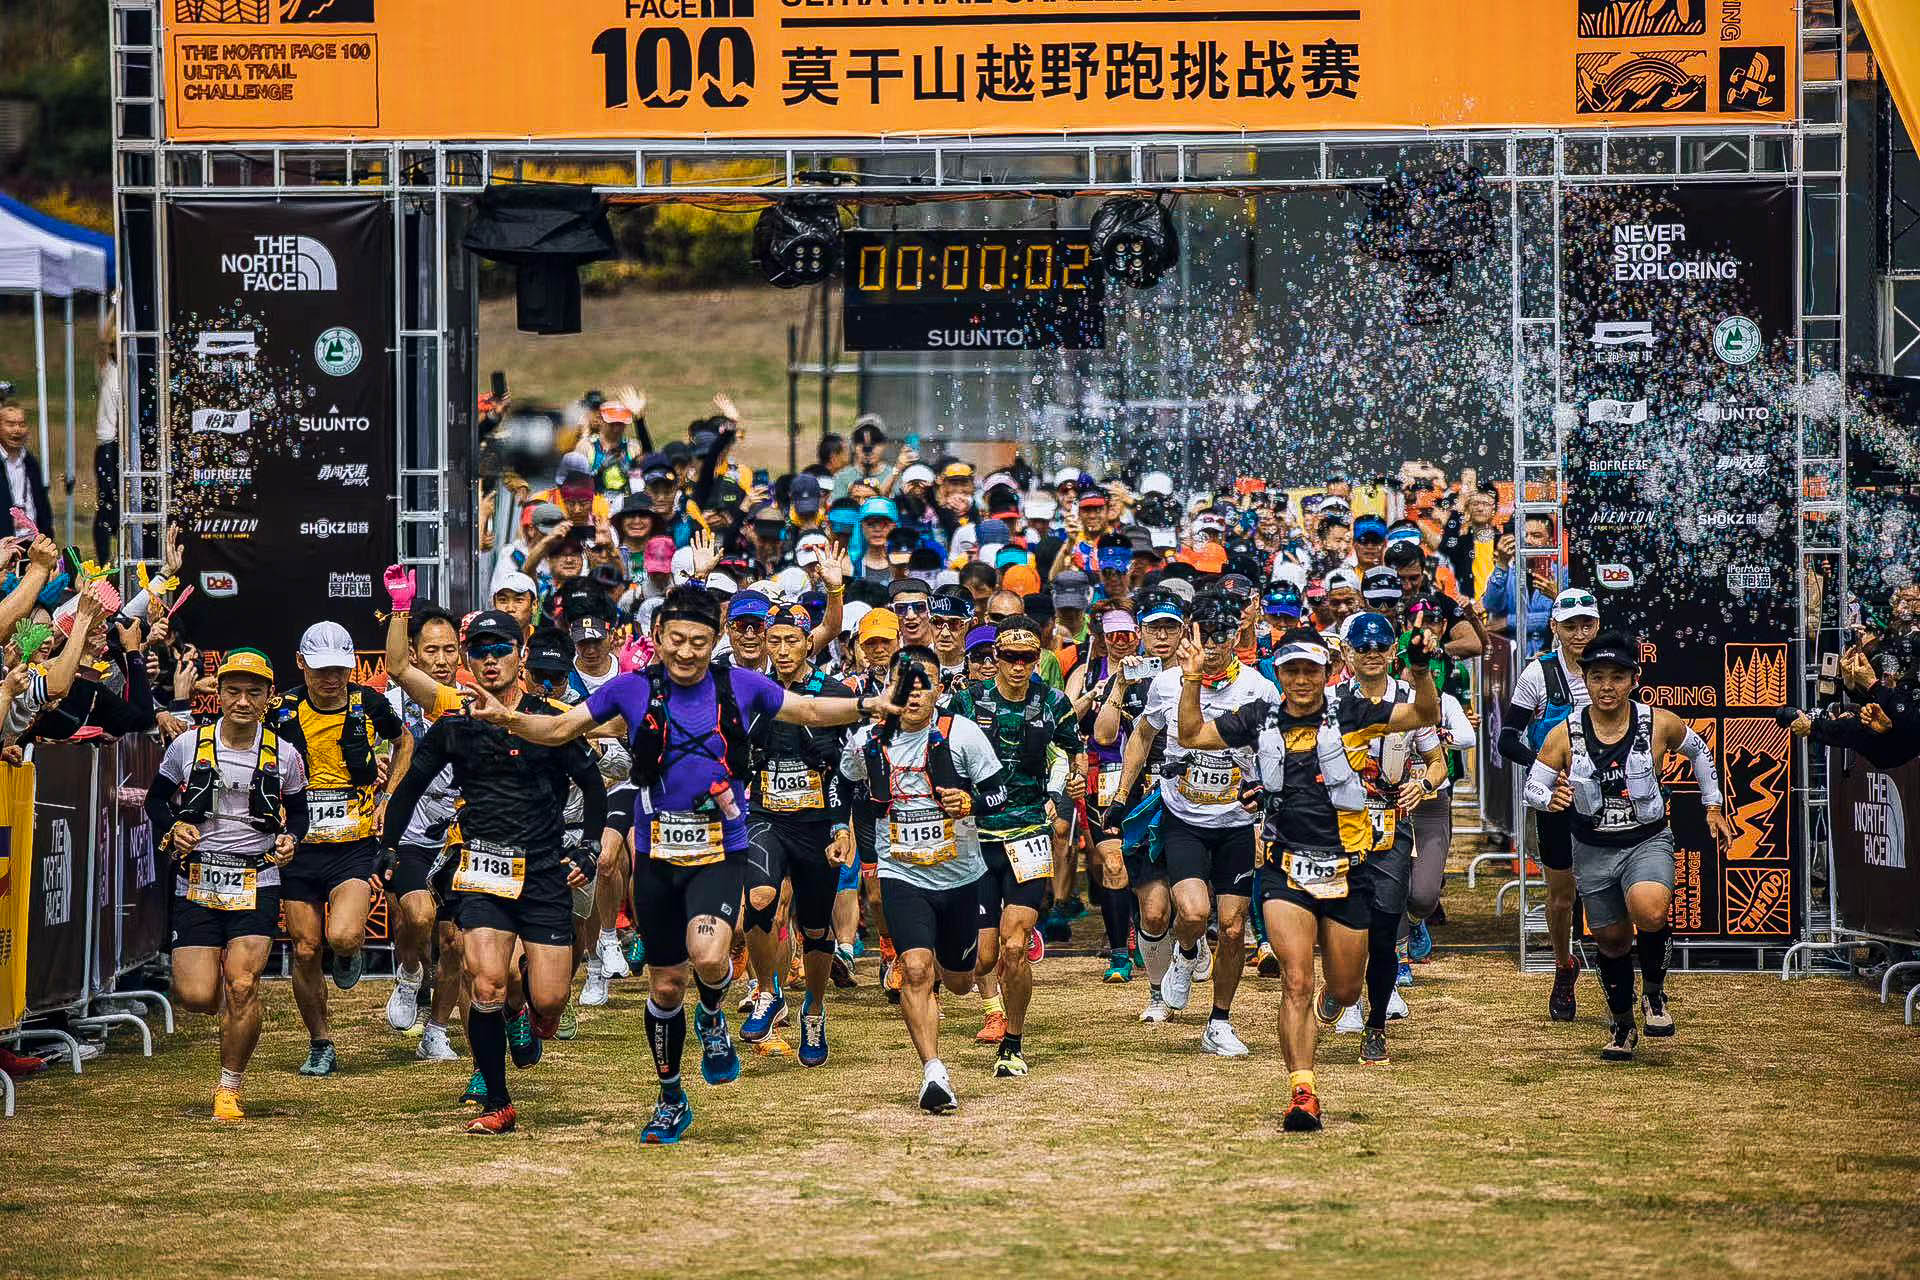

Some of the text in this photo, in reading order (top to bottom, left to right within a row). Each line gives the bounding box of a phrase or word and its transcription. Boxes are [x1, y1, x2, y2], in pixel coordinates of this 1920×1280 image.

[181, 43, 371, 61] THE NORTH FACE 100
[183, 63, 298, 80] ULTRA TRAIL
[591, 26, 755, 109] 100
[781, 38, 1361, 107] 莫干山越野跑挑战赛
[183, 83, 294, 101] CHALLENGE
[1614, 223, 1686, 242] NEVER
[254, 235, 297, 254] THE
[1614, 243, 1671, 263] STOP
[221, 254, 297, 273] NORTH
[858, 244, 1091, 291] 00:00:02
[243, 273, 297, 291] FACE
[927, 329, 1024, 347] SUUNTO
[1697, 406, 1769, 421] SUNTO
[299, 416, 370, 432] SUUNTO
[1698, 511, 1745, 527] SHOKZ
[300, 520, 346, 537] SHOKZ
[207, 576, 233, 590] Dole
[1602, 568, 1630, 582] Dole
[1639, 685, 1717, 707] ORING
[1691, 736, 1719, 781] SUUNTO
[772, 776, 808, 790] 1036
[1192, 769, 1229, 785] 1156
[1867, 772, 1887, 804] THE
[309, 805, 345, 821] 1145
[1854, 802, 1888, 833] NORTH
[664, 829, 707, 843] 1062
[901, 825, 942, 841] 1158
[1864, 834, 1890, 866] FACE
[472, 856, 511, 876] 1138
[203, 868, 242, 886] 1012
[1674, 848, 1687, 929] ULTRA TRAIL
[1688, 851, 1702, 929] CHALLENGE
